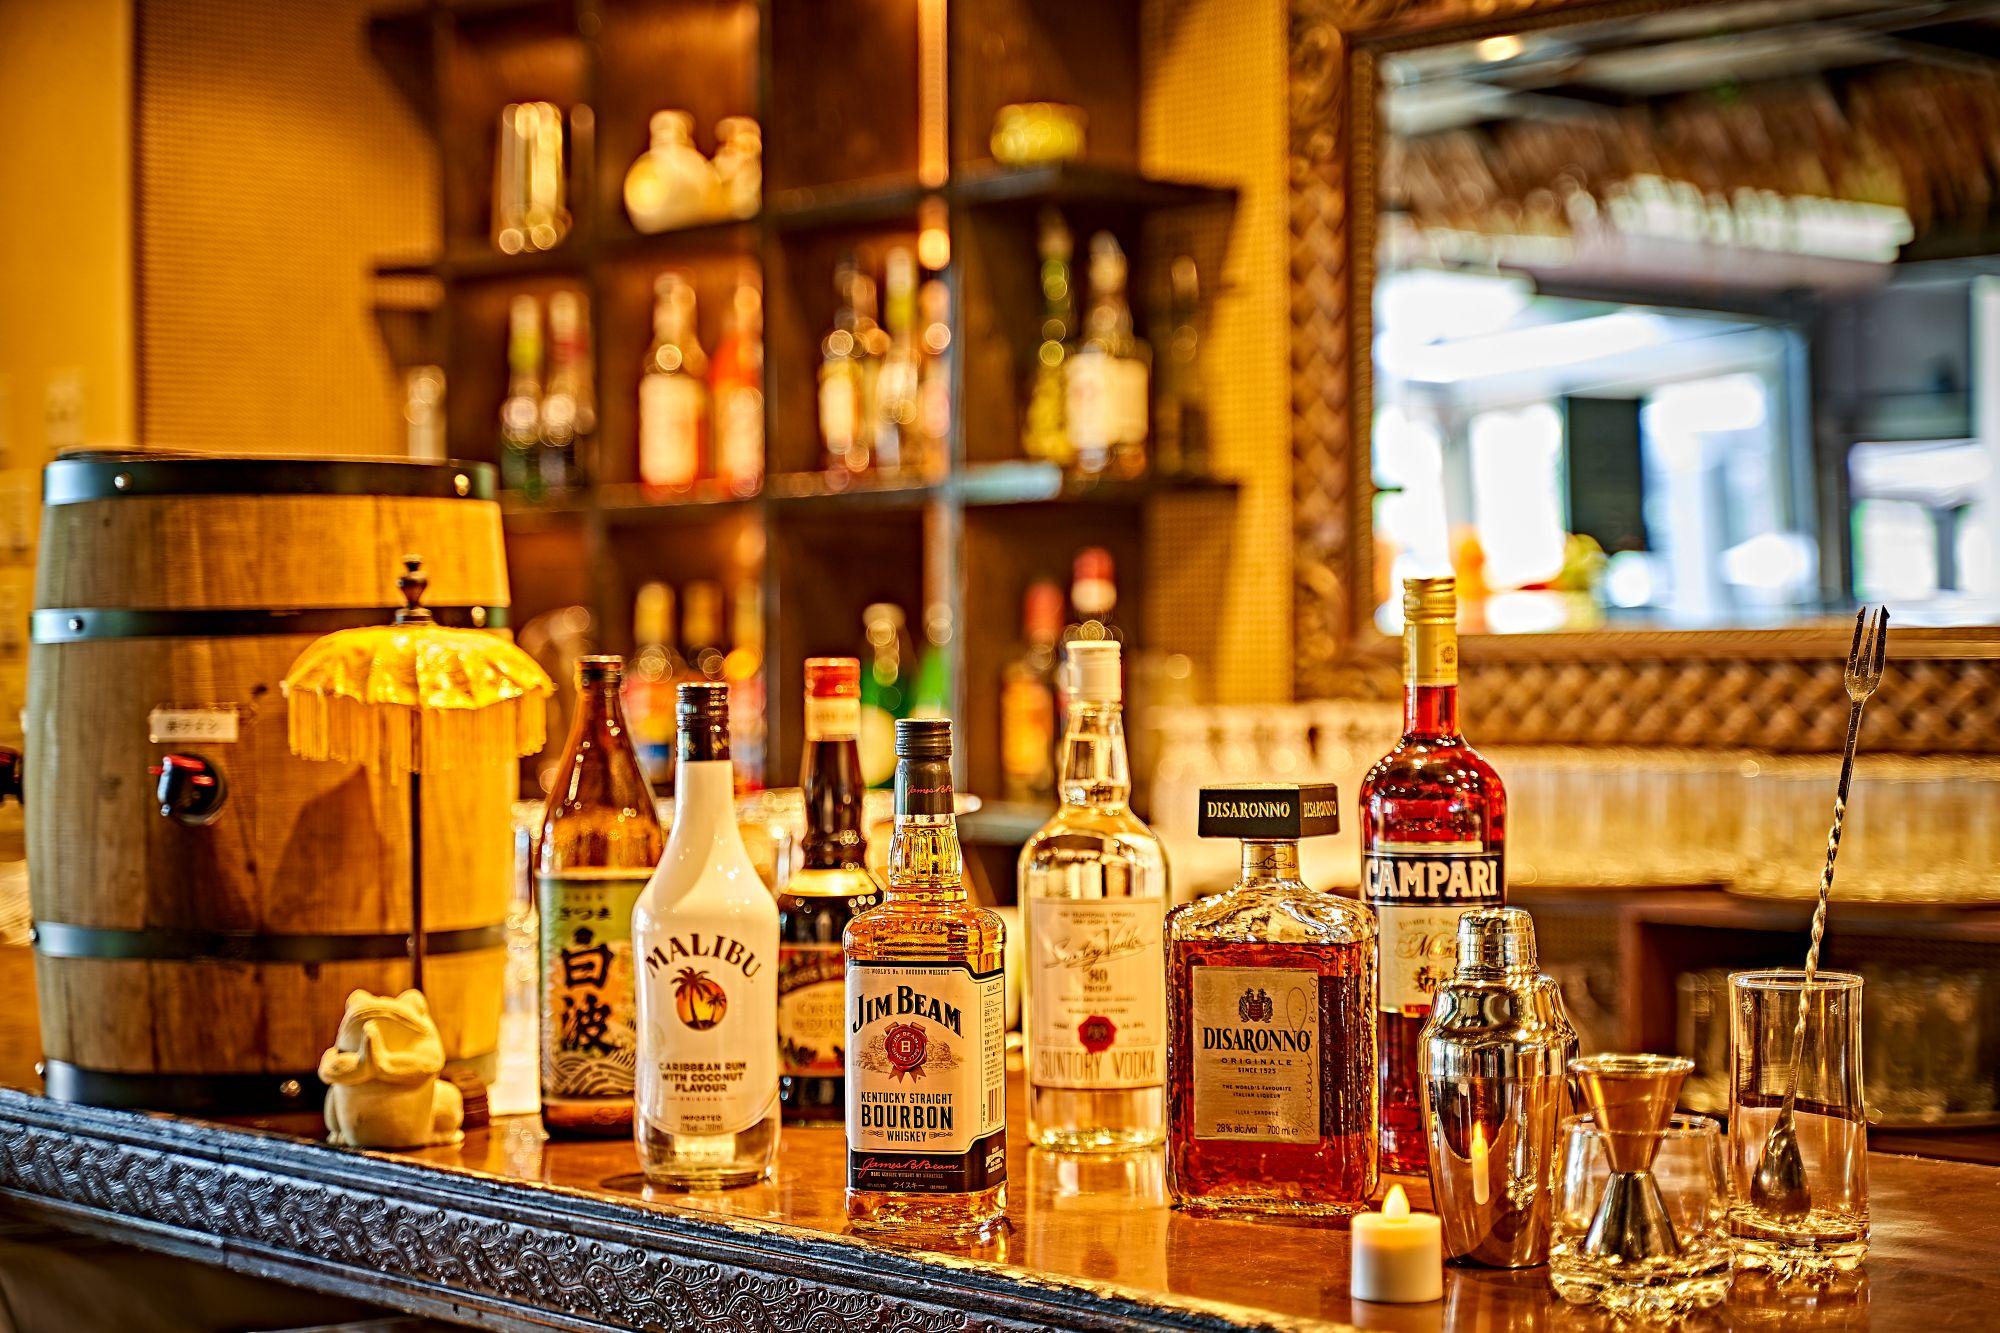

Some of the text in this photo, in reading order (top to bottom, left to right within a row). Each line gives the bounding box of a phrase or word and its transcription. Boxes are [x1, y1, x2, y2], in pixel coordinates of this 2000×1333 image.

[1207, 801, 1291, 819] DISARONNO
[1303, 801, 1337, 819] DISARONNO
[1366, 860, 1498, 898] CAMPARI
[646, 933, 761, 979] MALIBU
[561, 927, 622, 1058] 白波
[852, 993, 894, 1034] JIM
[896, 985, 963, 1038] BEAM
[901, 1040, 911, 1053] B
[1203, 1027, 1311, 1053] DISARONNO
[658, 1061, 747, 1071] CARIBBEAN RUM
[1041, 1051, 1157, 1081] SUNTORY VODKA
[1221, 1057, 1293, 1066] ORIGINALE
[662, 1072, 744, 1082] WITH COCONUT
[1259, 1067, 1277, 1075] 1525
[675, 1083, 728, 1093] FLAVOUR
[861, 1091, 953, 1105] KENTUCKY STRAIGHT
[861, 1104, 954, 1131] BOURBON
[886, 1130, 927, 1143] WHISKEY
[1216, 1123, 1233, 1133] 28%
[1267, 1125, 1280, 1135] 700
[857, 1157, 905, 1179] James
[919, 1159, 959, 1170] Beam
[892, 1181, 926, 1190] ウイスキー
